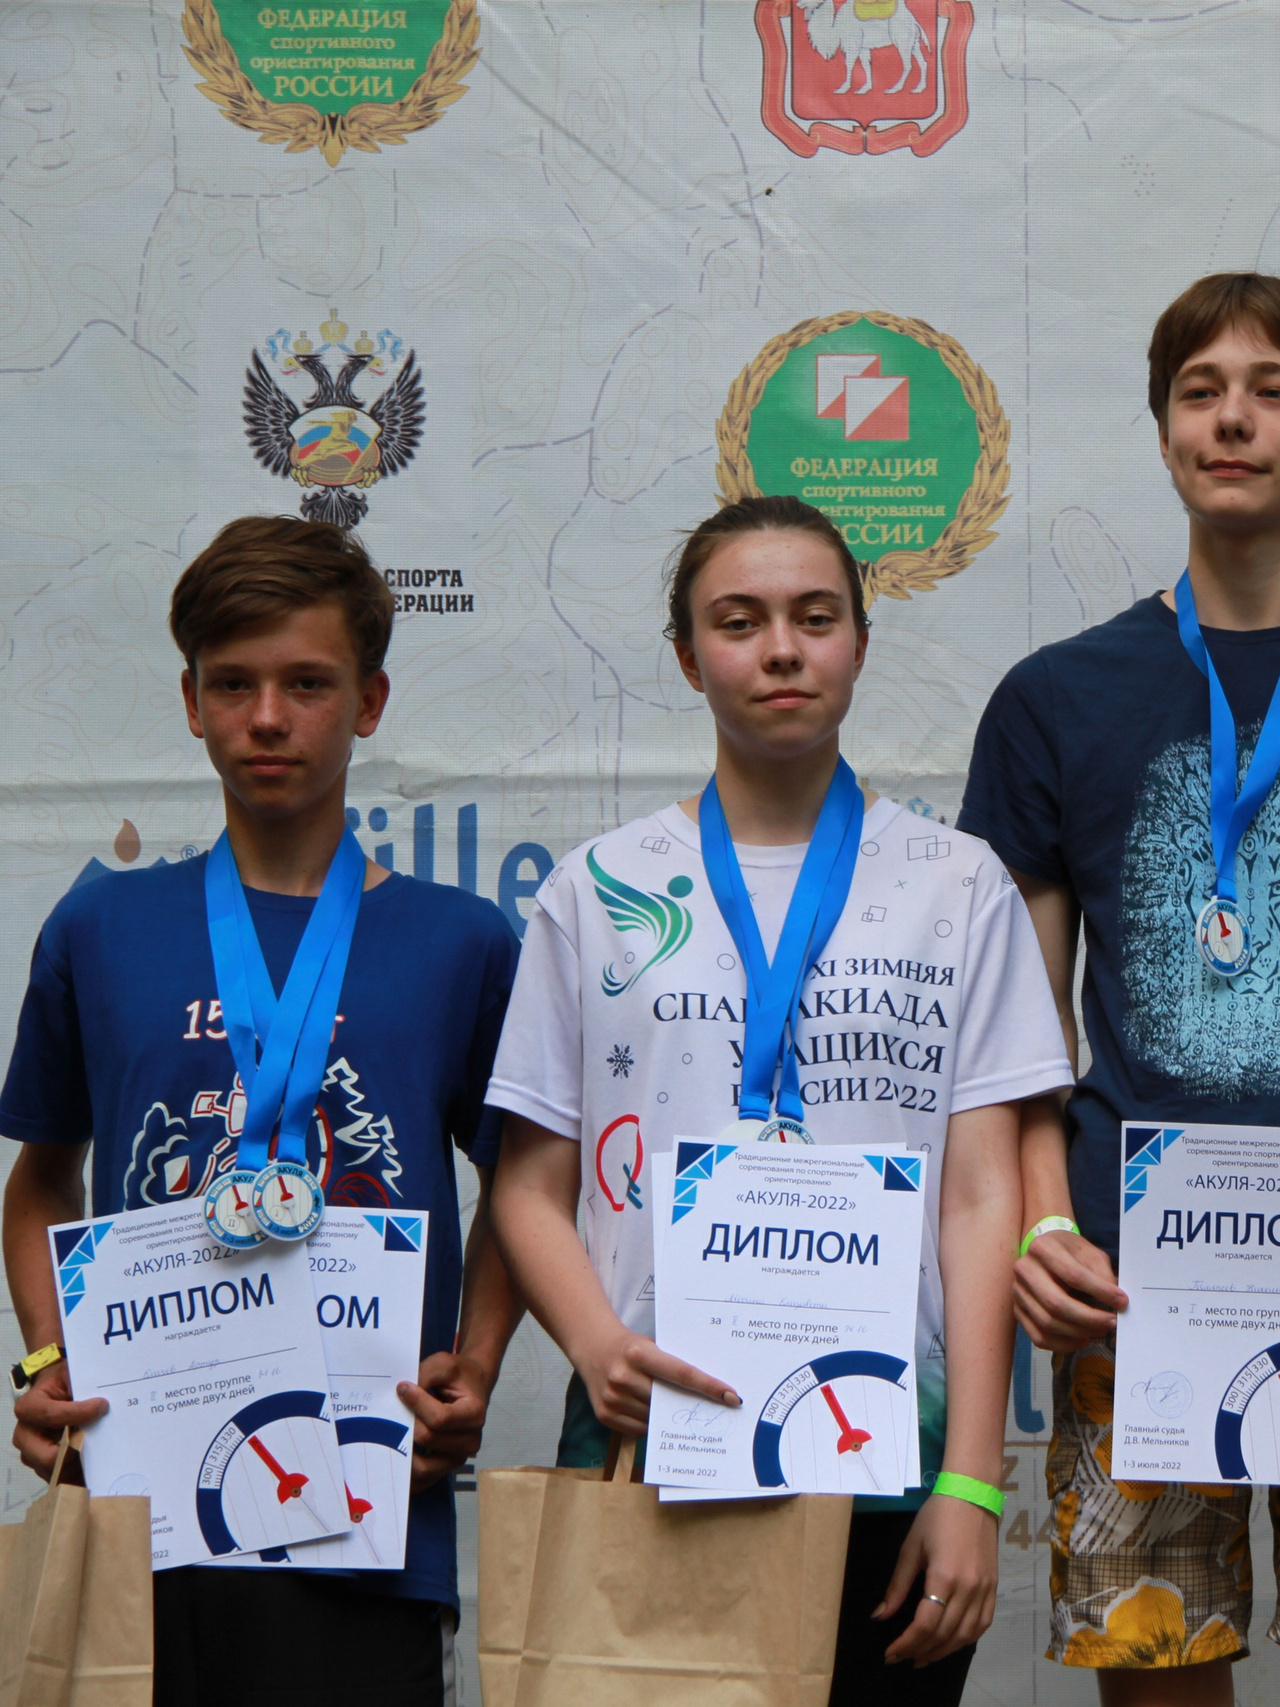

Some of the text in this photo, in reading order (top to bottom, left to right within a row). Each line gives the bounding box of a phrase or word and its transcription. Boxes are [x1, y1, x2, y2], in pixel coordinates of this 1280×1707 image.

[257, 8, 407, 32] ФЕДЕРАЦИЯ
[270, 37, 396, 54] спортивного
[250, 57, 415, 74] ориентирования
[273, 76, 394, 98] РОССИИ
[790, 457, 938, 481] ФЕДЕРАЦИЯ
[802, 485, 927, 501] спортивного
[820, 505, 946, 521] ентирования
[838, 522, 924, 545] ССИИ
[384, 568, 464, 587] СПОРТА
[394, 594, 474, 615] ЕРАЦИИ
[844, 957, 956, 987] ЗИМНЯЯ
[653, 984, 949, 1031] СПАКИАДА
[1181, 1136, 1238, 1147] Традиционные
[734, 1152, 864, 1168] Традиционные межрегиональные
[1186, 1148, 1241, 1157] соревнования
[739, 1163, 794, 1174] соревнования
[807, 1169, 858, 1179] спортивному
[1212, 1159, 1279, 1169] ориентированию
[764, 1176, 831, 1187] ориентированию
[736, 1190, 856, 1211] «АКУЛЯ-2022»
[111, 1216, 168, 1235] Традиционные
[119, 1228, 173, 1244] соревнования
[174, 1226, 184, 1235] по
[702, 1223, 879, 1266] ДИПЛОМ
[1215, 1252, 1272, 1261] награждается
[761, 1266, 820, 1277] награждается
[103, 1273, 275, 1345] ДИПЛОМ
[1167, 1306, 1179, 1314] за
[1205, 1307, 1237, 1317] место
[1239, 1308, 1253, 1317] по
[164, 1324, 221, 1341] награждается
[710, 1317, 838, 1335] за место по группе
[1189, 1318, 1202, 1327] по
[1205, 1319, 1239, 1331] сумме
[1241, 1320, 1266, 1330] двух
[731, 1330, 839, 1346] по сумме двух дней
[1252, 1357, 1269, 1373] 330
[794, 1370, 811, 1385] 330
[1237, 1371, 1253, 1388] 315
[127, 1375, 251, 1407] за место по группе
[151, 1384, 255, 1415] по сумме двух дней
[778, 1383, 794, 1400] 315
[1226, 1391, 1239, 1409] 300
[765, 1402, 780, 1420] 300
[220, 1427, 236, 1445] 330
[660, 1431, 723, 1444] Главный судья
[1125, 1424, 1185, 1435] Главный судья
[660, 1443, 726, 1454] Д.В. Мельников
[1124, 1436, 1189, 1446] Д.В. Мельников
[209, 1445, 223, 1462] 315
[658, 1465, 717, 1477] 1-3 июля 2022
[1123, 1460, 1181, 1470] 1-3 июля 2022
[202, 1467, 214, 1486] 300
